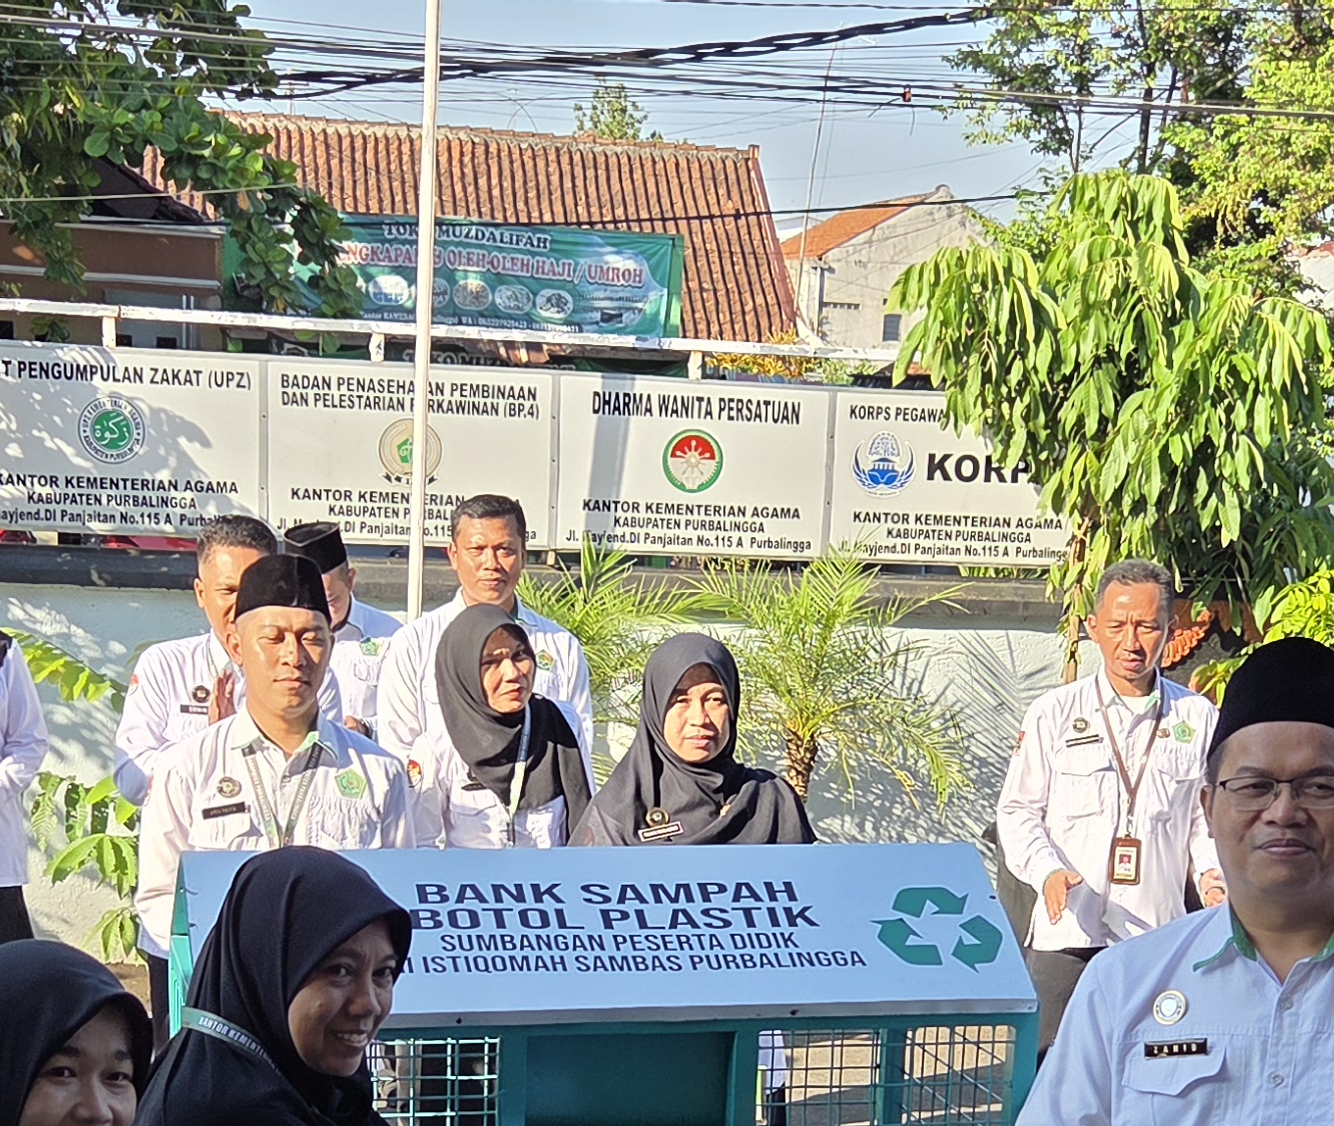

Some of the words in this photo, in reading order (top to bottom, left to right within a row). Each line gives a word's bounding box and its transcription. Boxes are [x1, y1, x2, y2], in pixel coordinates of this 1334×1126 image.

[384, 225, 419, 239] TOK
[437, 227, 549, 249] MUZDALIFAH
[447, 249, 531, 274] OLEH-OLEH
[534, 257, 572, 279] HAJI
[586, 262, 644, 286] UMROH
[17, 361, 144, 384] PENGUMPULAN
[149, 368, 203, 387] ZAKAT
[208, 370, 252, 390] (UPZ)
[281, 373, 332, 391] BADAN
[337, 376, 445, 397] PENASEHAAN
[450, 382, 537, 402] PEMBINAAN
[281, 391, 309, 407] DAN
[314, 393, 405, 412] PELESTARIAN
[410, 397, 499, 417] RKAWINAN
[503, 402, 539, 420] (BP.4)
[592, 391, 654, 417] DHARMA
[658, 393, 713, 420] WANITA
[718, 397, 801, 425] PERSATUAN
[850, 404, 892, 422] KORPS
[895, 406, 945, 424] PEGAWA
[926, 453, 1029, 484] KORP
[65, 476, 178, 492] KEMENTERIAN
[184, 480, 238, 494] AGAMA
[27, 491, 102, 507] KABUPATEN
[106, 494, 197, 510] PURBALINGGA
[291, 488, 353, 503] KANTOR
[358, 490, 465, 507] KEMENRIAN
[61, 509, 116, 526] Panjaitan
[120, 511, 160, 526] No.115
[164, 512, 173, 526] A
[328, 504, 399, 519] KABUPATEN
[582, 499, 640, 514] KANTOR
[645, 502, 747, 519] KEMENTERIAN
[751, 506, 801, 520] AGAMA
[423, 523, 453, 538] o.115
[614, 516, 681, 530] KABUPATEN
[685, 519, 765, 534] PURBALINGGA
[853, 511, 910, 525] KANTOR
[914, 513, 1011, 529] KEMENTERIAN
[1015, 516, 1063, 531] AGAMA
[644, 532, 694, 549] Panjaitan
[697, 534, 733, 549] No.115
[736, 536, 744, 549] A
[750, 537, 812, 553] Purbalingga
[886, 527, 952, 542] KABUPATEN
[955, 530, 1032, 545] PURBALINGGA
[914, 543, 961, 559] Panjaitan
[964, 545, 999, 559] No.115
[1002, 546, 1010, 559] A
[415, 883, 567, 904] BANK
[579, 881, 799, 905] SAMPAH
[410, 908, 585, 930] BOTOL
[599, 905, 820, 930] PLASTIK
[440, 934, 606, 952] SUMBANGAN
[613, 933, 725, 951] PESERTA
[729, 931, 800, 950] DIDIK
[422, 955, 568, 973] ISTIQOMAH
[574, 953, 683, 972] SAMBAS
[689, 950, 867, 971] PURBALINGGA
